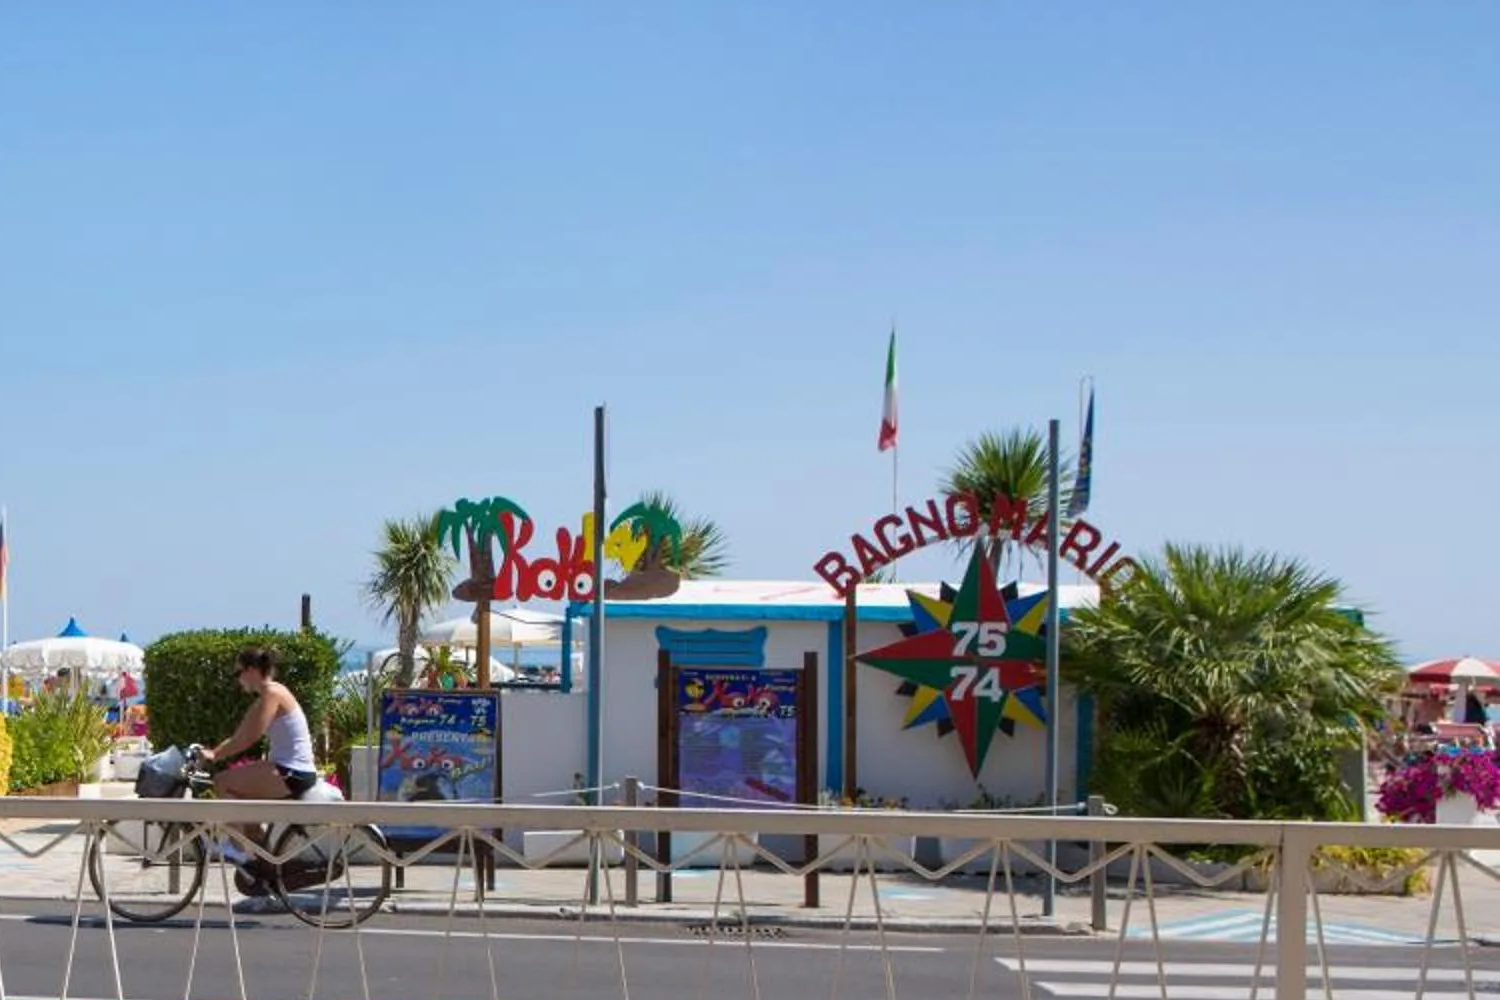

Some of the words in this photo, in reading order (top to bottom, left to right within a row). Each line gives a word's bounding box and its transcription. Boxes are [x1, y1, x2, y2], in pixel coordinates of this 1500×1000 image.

[813, 490, 980, 599] BAGNO
[952, 621, 1008, 657] 75
[950, 666, 1003, 701] 74
